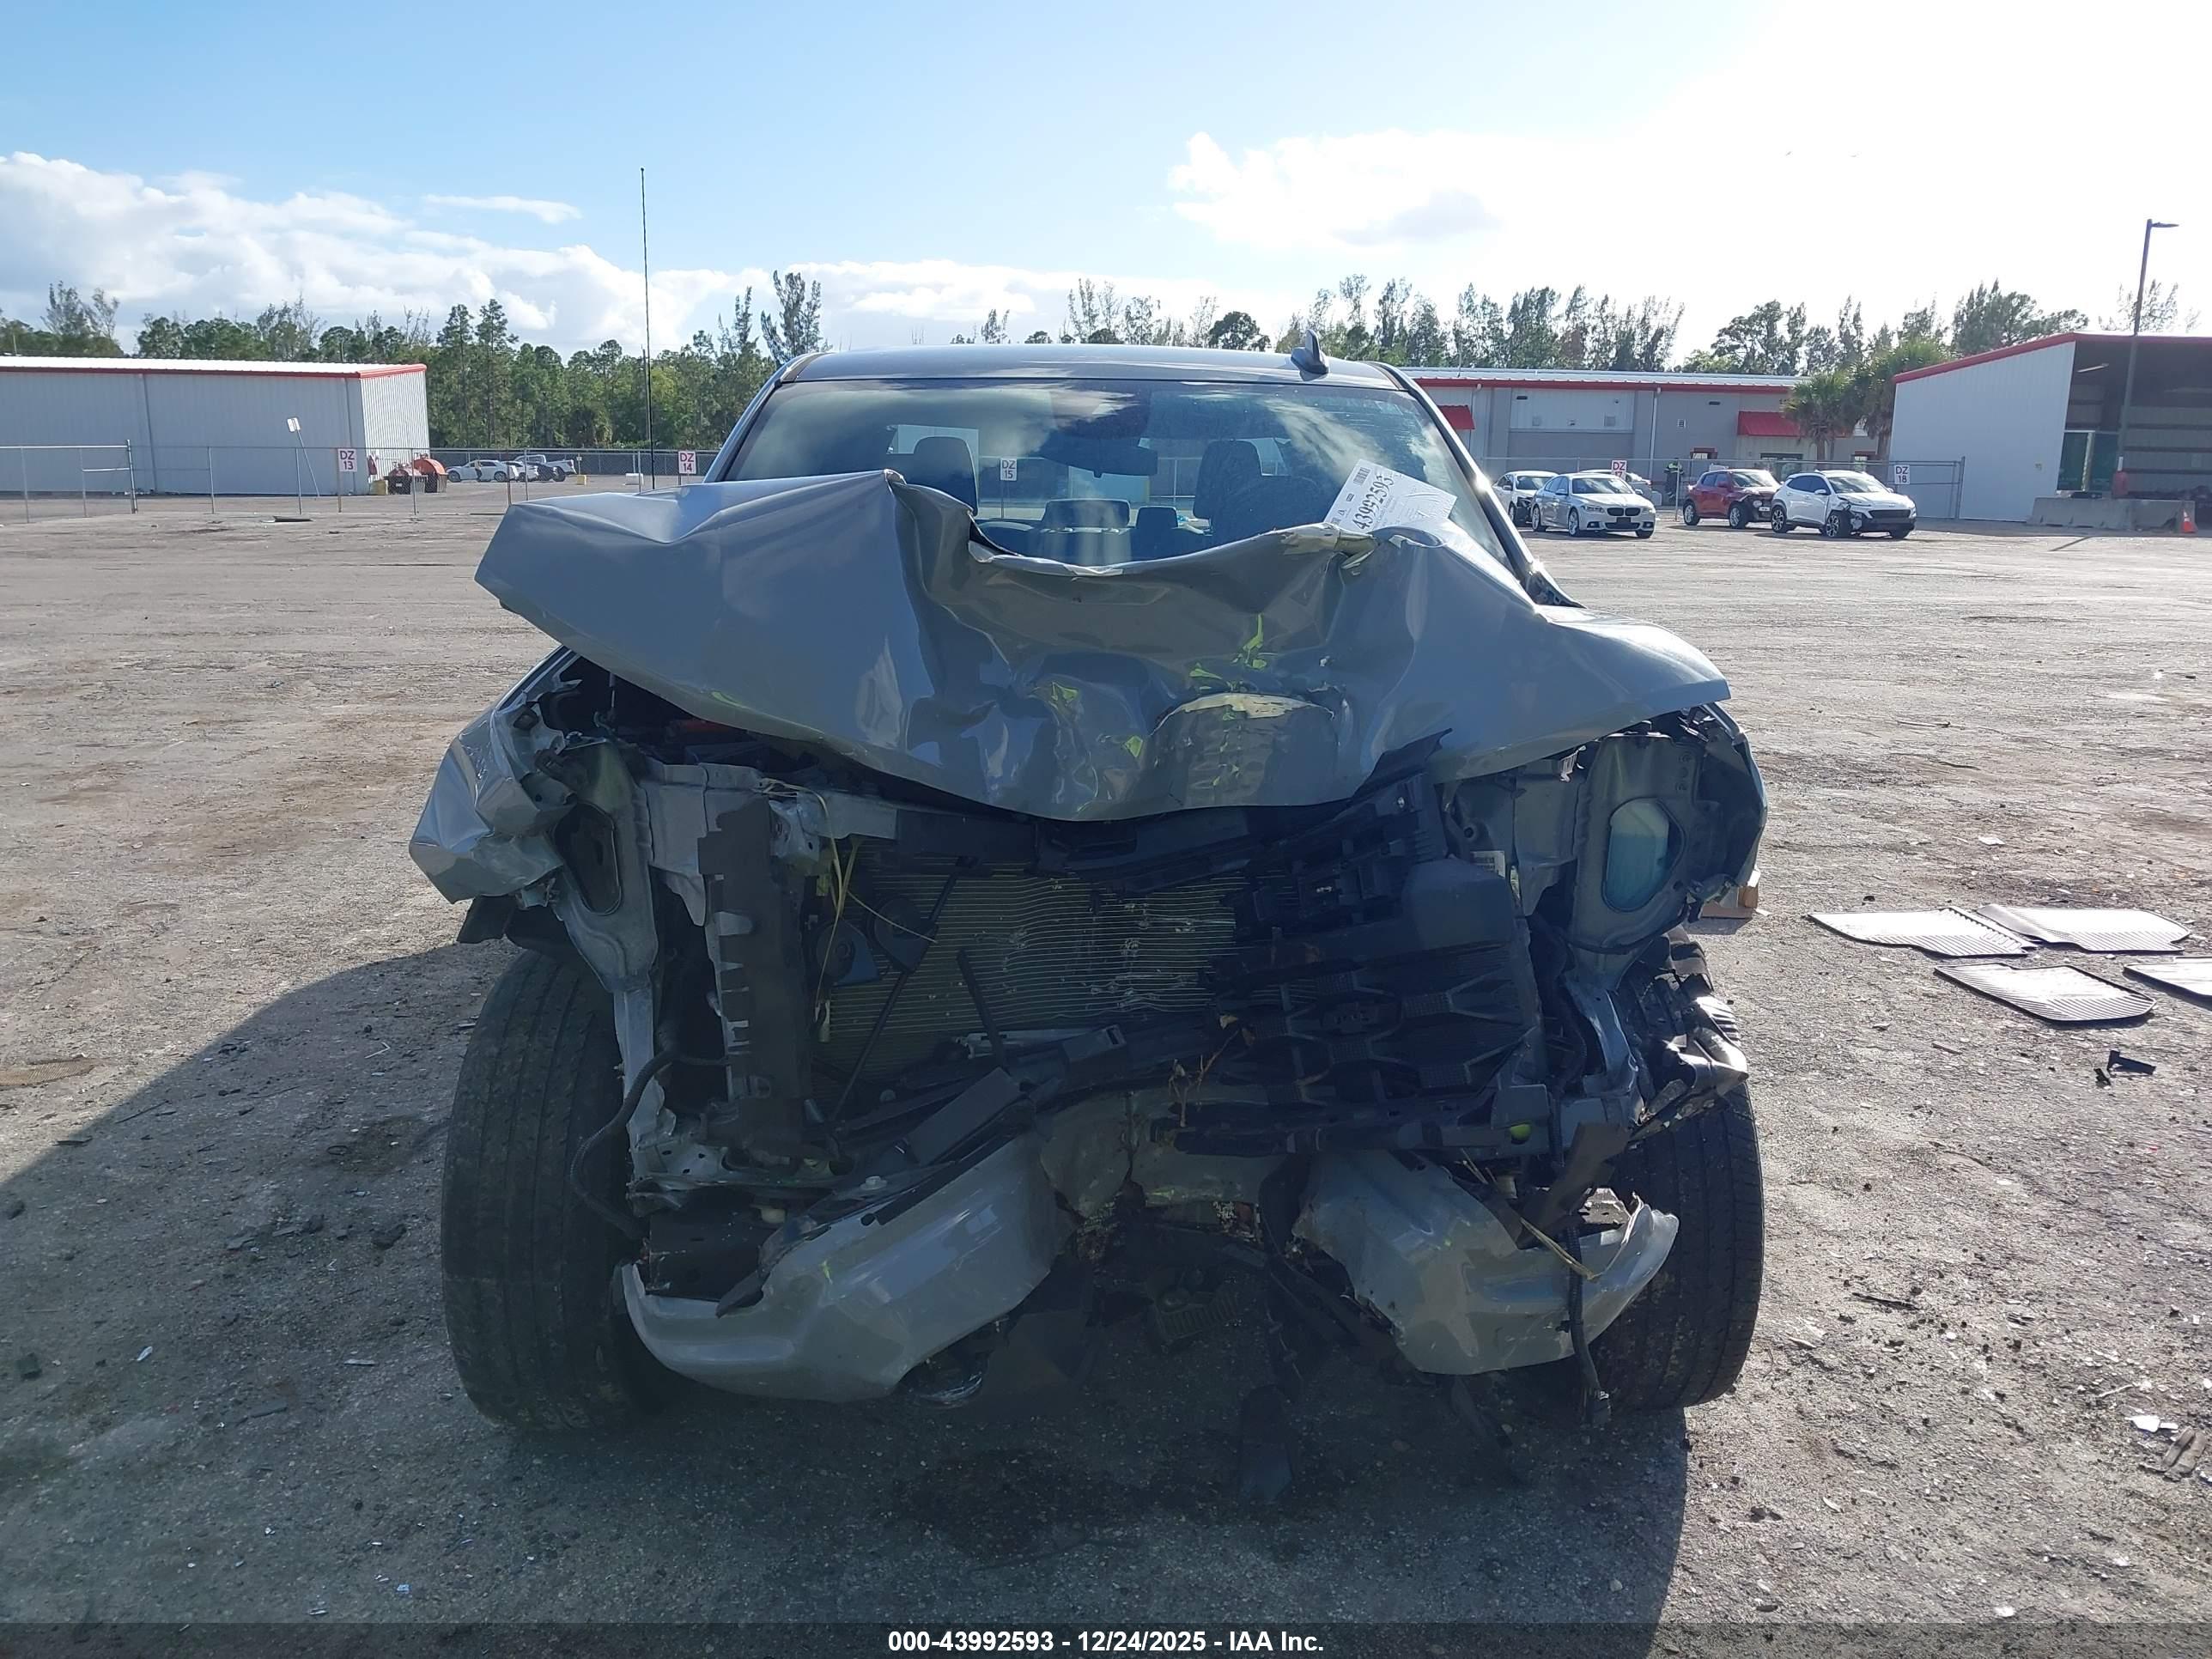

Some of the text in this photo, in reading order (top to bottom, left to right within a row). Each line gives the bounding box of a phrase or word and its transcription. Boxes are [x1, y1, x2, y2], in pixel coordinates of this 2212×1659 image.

[340, 451, 355, 460] DZ
[680, 453, 695, 462] DZ
[343, 461, 354, 470] 13
[684, 463, 692, 472] 14
[1002, 459, 1016, 469] DZ
[1613, 461, 1626, 471] DZ
[1005, 470, 1013, 479] 15
[1895, 466, 1908, 475] DZ
[1899, 475, 1907, 483] 18
[1352, 473, 1395, 530] 43992593
